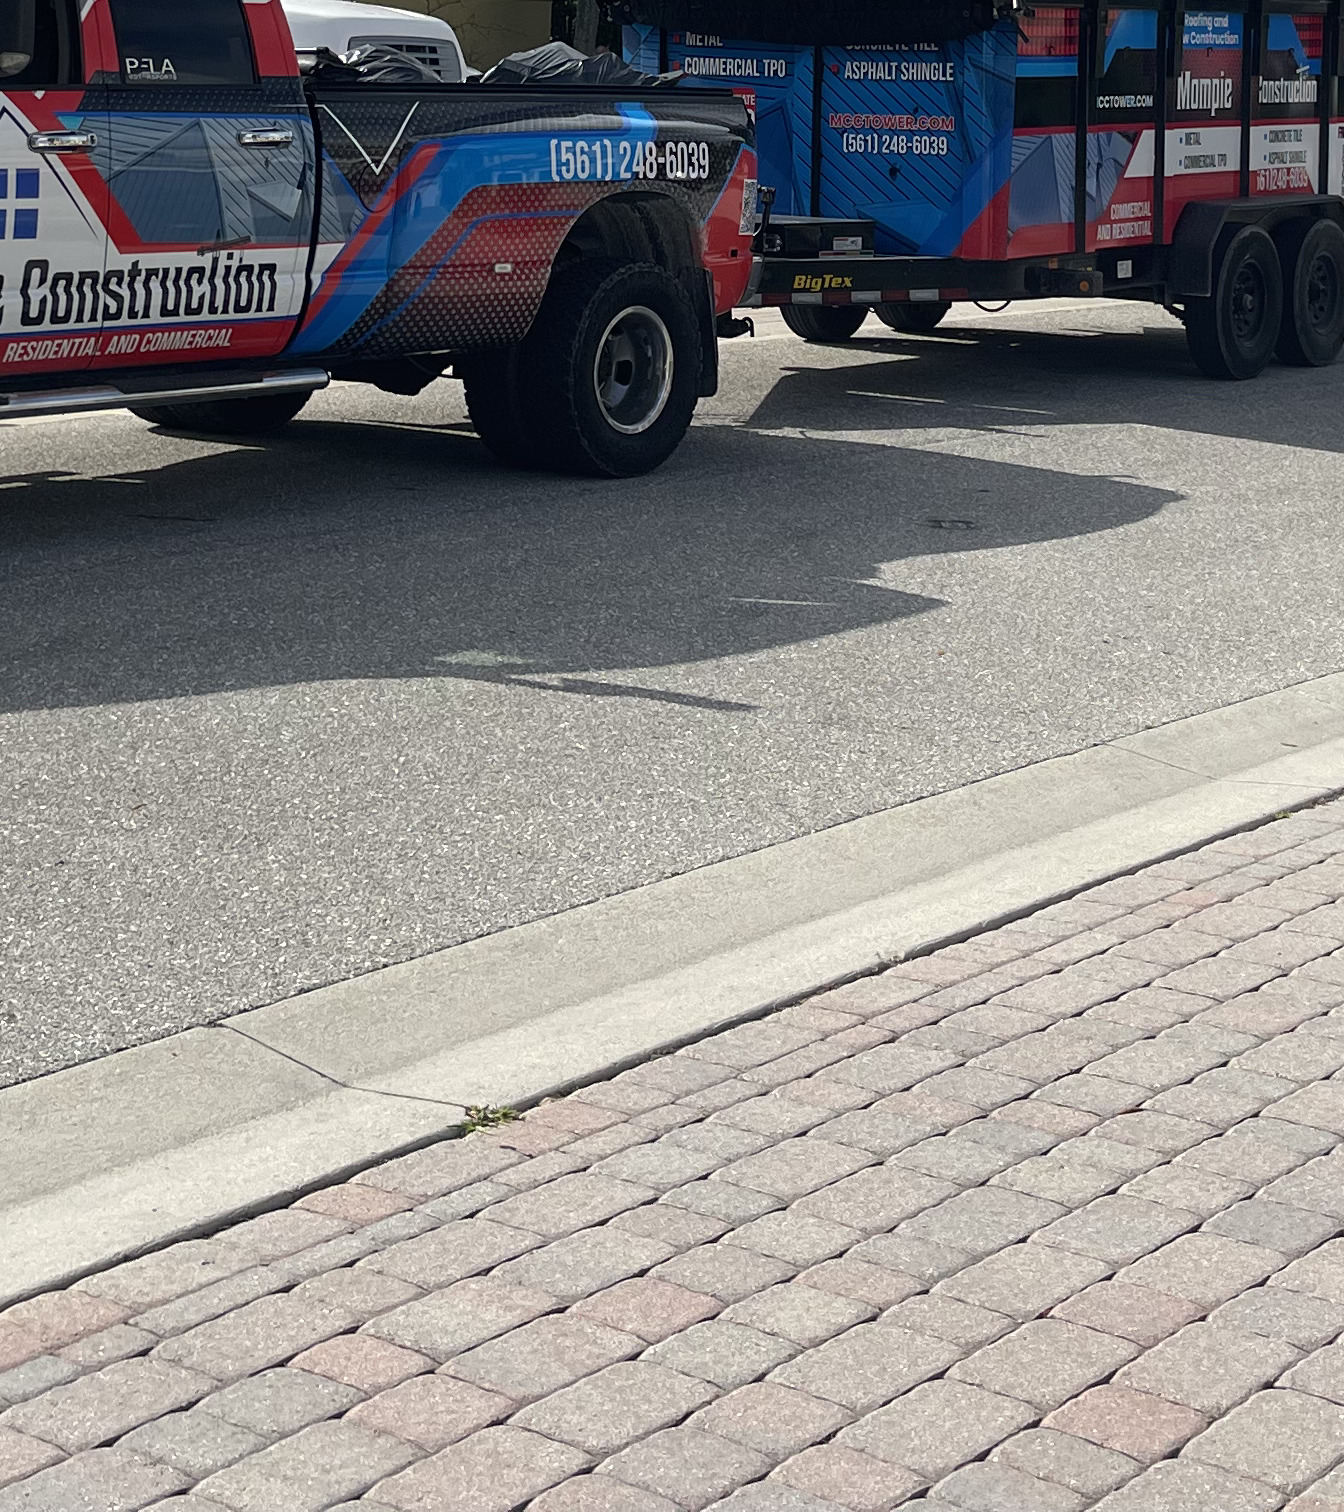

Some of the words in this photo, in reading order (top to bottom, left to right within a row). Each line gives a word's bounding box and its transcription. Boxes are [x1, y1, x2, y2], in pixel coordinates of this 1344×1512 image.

[1184, 12, 1212, 31] Roofing
[1213, 14, 1229, 27] and
[1190, 31, 1239, 44] Construction
[684, 57, 760, 76] COMMERCIAL
[763, 59, 786, 78] TPO
[844, 61, 898, 80] ASPHALT
[900, 62, 954, 81] SHINGLE
[1176, 70, 1233, 117] Mompie
[829, 113, 955, 131] MCCTOWER.COM
[842, 132, 878, 154] (561)
[881, 134, 948, 155] 248-6039
[549, 138, 613, 182] (561)
[619, 140, 709, 180] 248-6039
[20, 252, 277, 328] Construction
[2, 336, 103, 363] RESIDENTIAL
[104, 334, 141, 356] AND
[140, 328, 232, 353] COMMERCIAL
